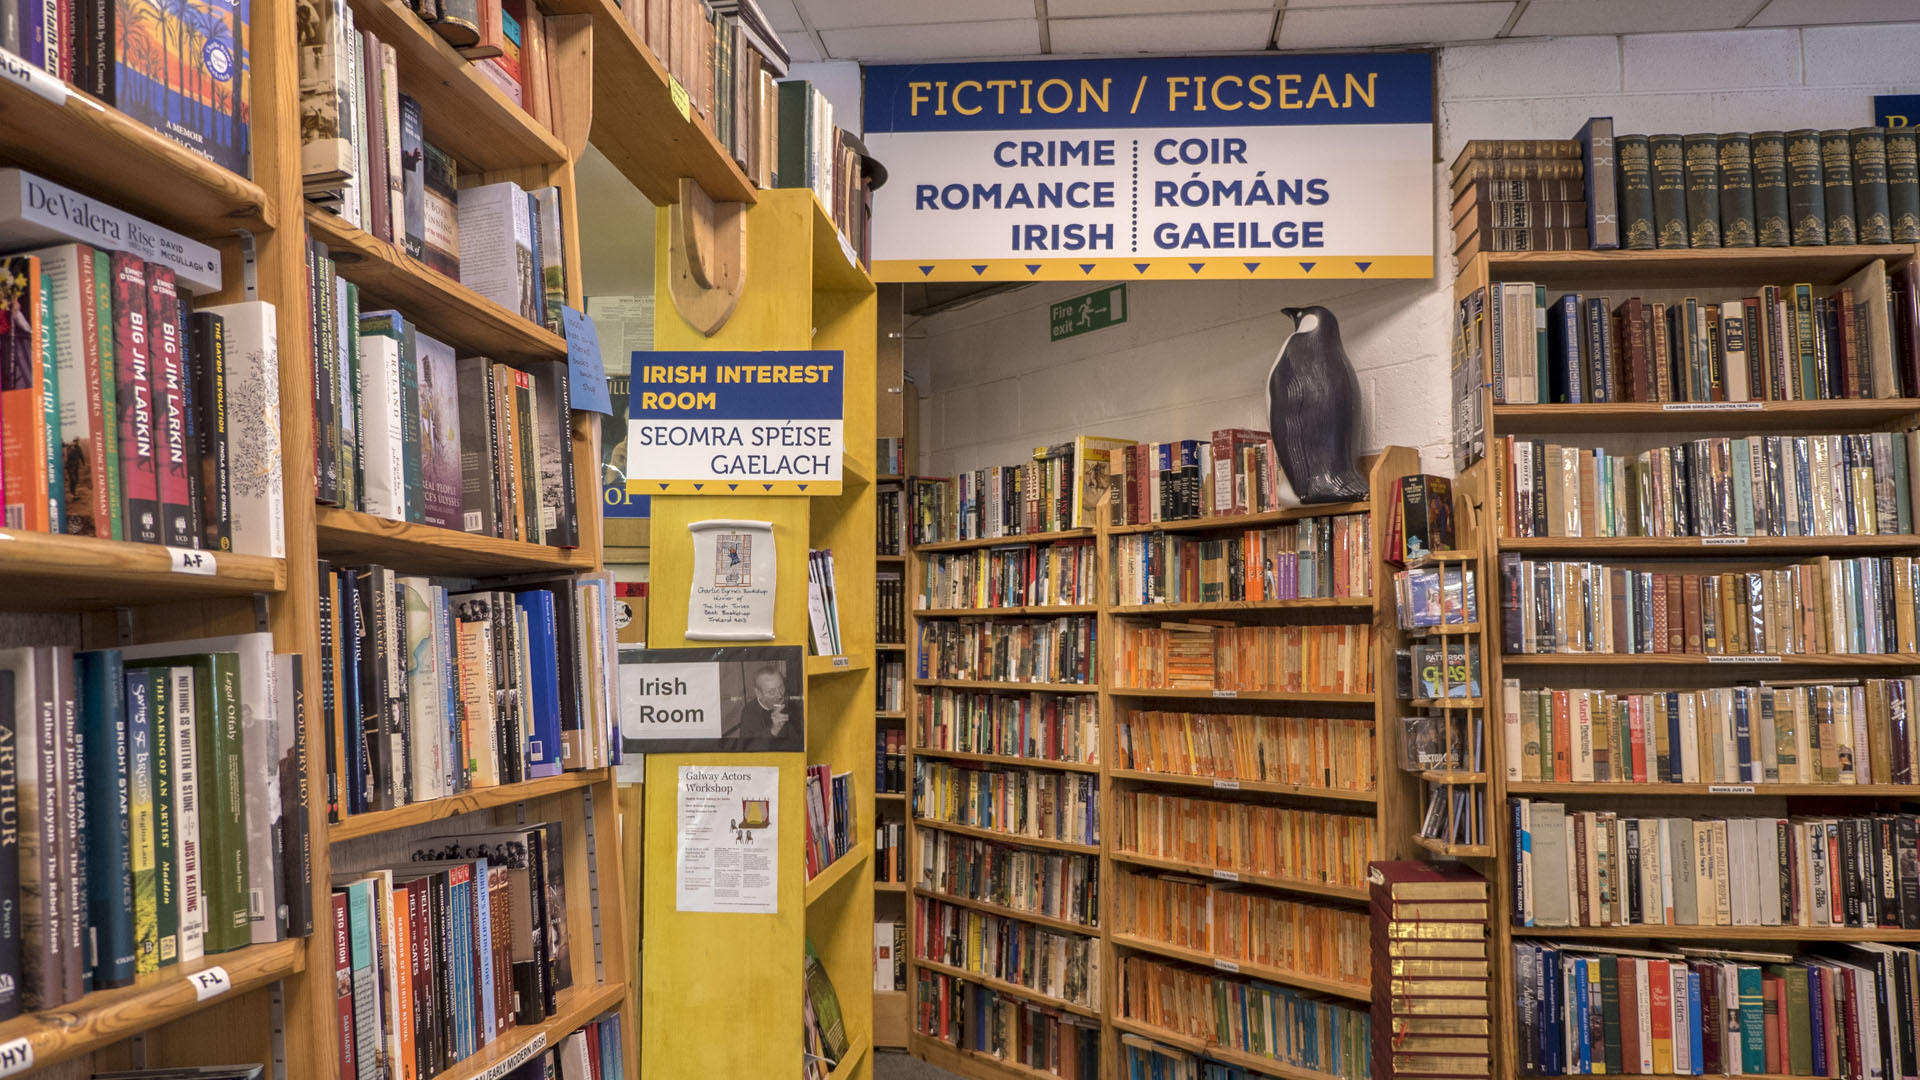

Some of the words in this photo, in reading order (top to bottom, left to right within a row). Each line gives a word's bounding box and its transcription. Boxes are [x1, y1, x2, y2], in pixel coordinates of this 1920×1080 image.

[908, 78, 1112, 116] FICTION
[1130, 75, 1148, 114] /
[1166, 72, 1378, 113] FICSEAN
[172, 124, 204, 144] MEMOIR
[993, 139, 1116, 168] CRIME
[1154, 138, 1248, 166] COIR
[916, 182, 1116, 211] ROMANCE
[1154, 171, 1330, 208] RÓMÁNS
[28, 181, 120, 240] DeValera
[128, 222, 155, 248] Rise
[160, 238, 184, 254] DAVID
[1010, 224, 1115, 251] IRISH
[1153, 221, 1324, 250] GAEILGE
[124, 267, 144, 276] EMMET
[160, 250, 204, 272] McCULLAGH
[156, 279, 174, 290] EMMET
[131, 312, 143, 343] BIG
[1053, 306, 1072, 320] Fire
[163, 322, 175, 352] BIG
[1053, 320, 1072, 336] exit
[133, 348, 147, 380] JIM
[164, 358, 178, 388] JIM
[643, 366, 707, 384] IRISH
[716, 365, 834, 384] INTEREST
[391, 352, 399, 418] IRELAND
[642, 392, 716, 410] ROOM
[136, 386, 150, 456] LARKIN
[167, 394, 182, 462] LARKIN
[640, 426, 744, 447] SEOMRA
[751, 420, 832, 447] SPÉISE
[710, 454, 831, 475] GAELACH
[184, 555, 203, 568] A-F
[375, 590, 383, 627] EASTER
[156, 676, 164, 701] THE
[178, 676, 190, 714] NOTHING
[224, 671, 235, 701] Legal
[296, 690, 303, 699] A
[639, 678, 687, 696] Irish
[43, 702, 54, 746] Father
[65, 700, 76, 744] Father
[180, 716, 191, 726] IS
[227, 705, 237, 740] Offaly
[639, 705, 704, 724] Room
[1578, 698, 1589, 724] Marsh
[158, 705, 167, 756] MAKING
[298, 702, 307, 775] COUNTRY
[116, 722, 127, 774] BRIGHT
[180, 729, 193, 769] WRITTEN
[44, 749, 54, 783] John
[66, 747, 76, 780] John
[159, 760, 168, 775] OF
[182, 772, 193, 783] IN
[686, 772, 719, 783] Galway
[722, 772, 752, 781] Actors
[119, 778, 128, 814] STAR
[160, 779, 168, 796] AN
[182, 785, 194, 813] STONE
[300, 779, 309, 809] BOY
[686, 784, 733, 794] Workshop
[45, 787, 56, 842] Kenyon
[66, 783, 78, 838] Kenyon
[121, 819, 129, 834] OF
[160, 803, 169, 848] ARTIST
[48, 856, 57, 878] The
[70, 852, 79, 874] The
[121, 842, 130, 871] THE
[185, 840, 196, 872] JUSTIN
[71, 877, 79, 910] Rebel
[122, 871, 132, 913] WEST
[162, 861, 171, 904] Madden
[186, 875, 198, 912] KEATING
[236, 875, 244, 893] Byrne
[49, 882, 58, 916] Rebel
[72, 914, 81, 948] Priest
[337, 907, 345, 929] INTO
[51, 919, 60, 954] Priest
[338, 931, 347, 963] ACTION
[200, 971, 223, 988] F-L
[400, 961, 405, 969] OF
